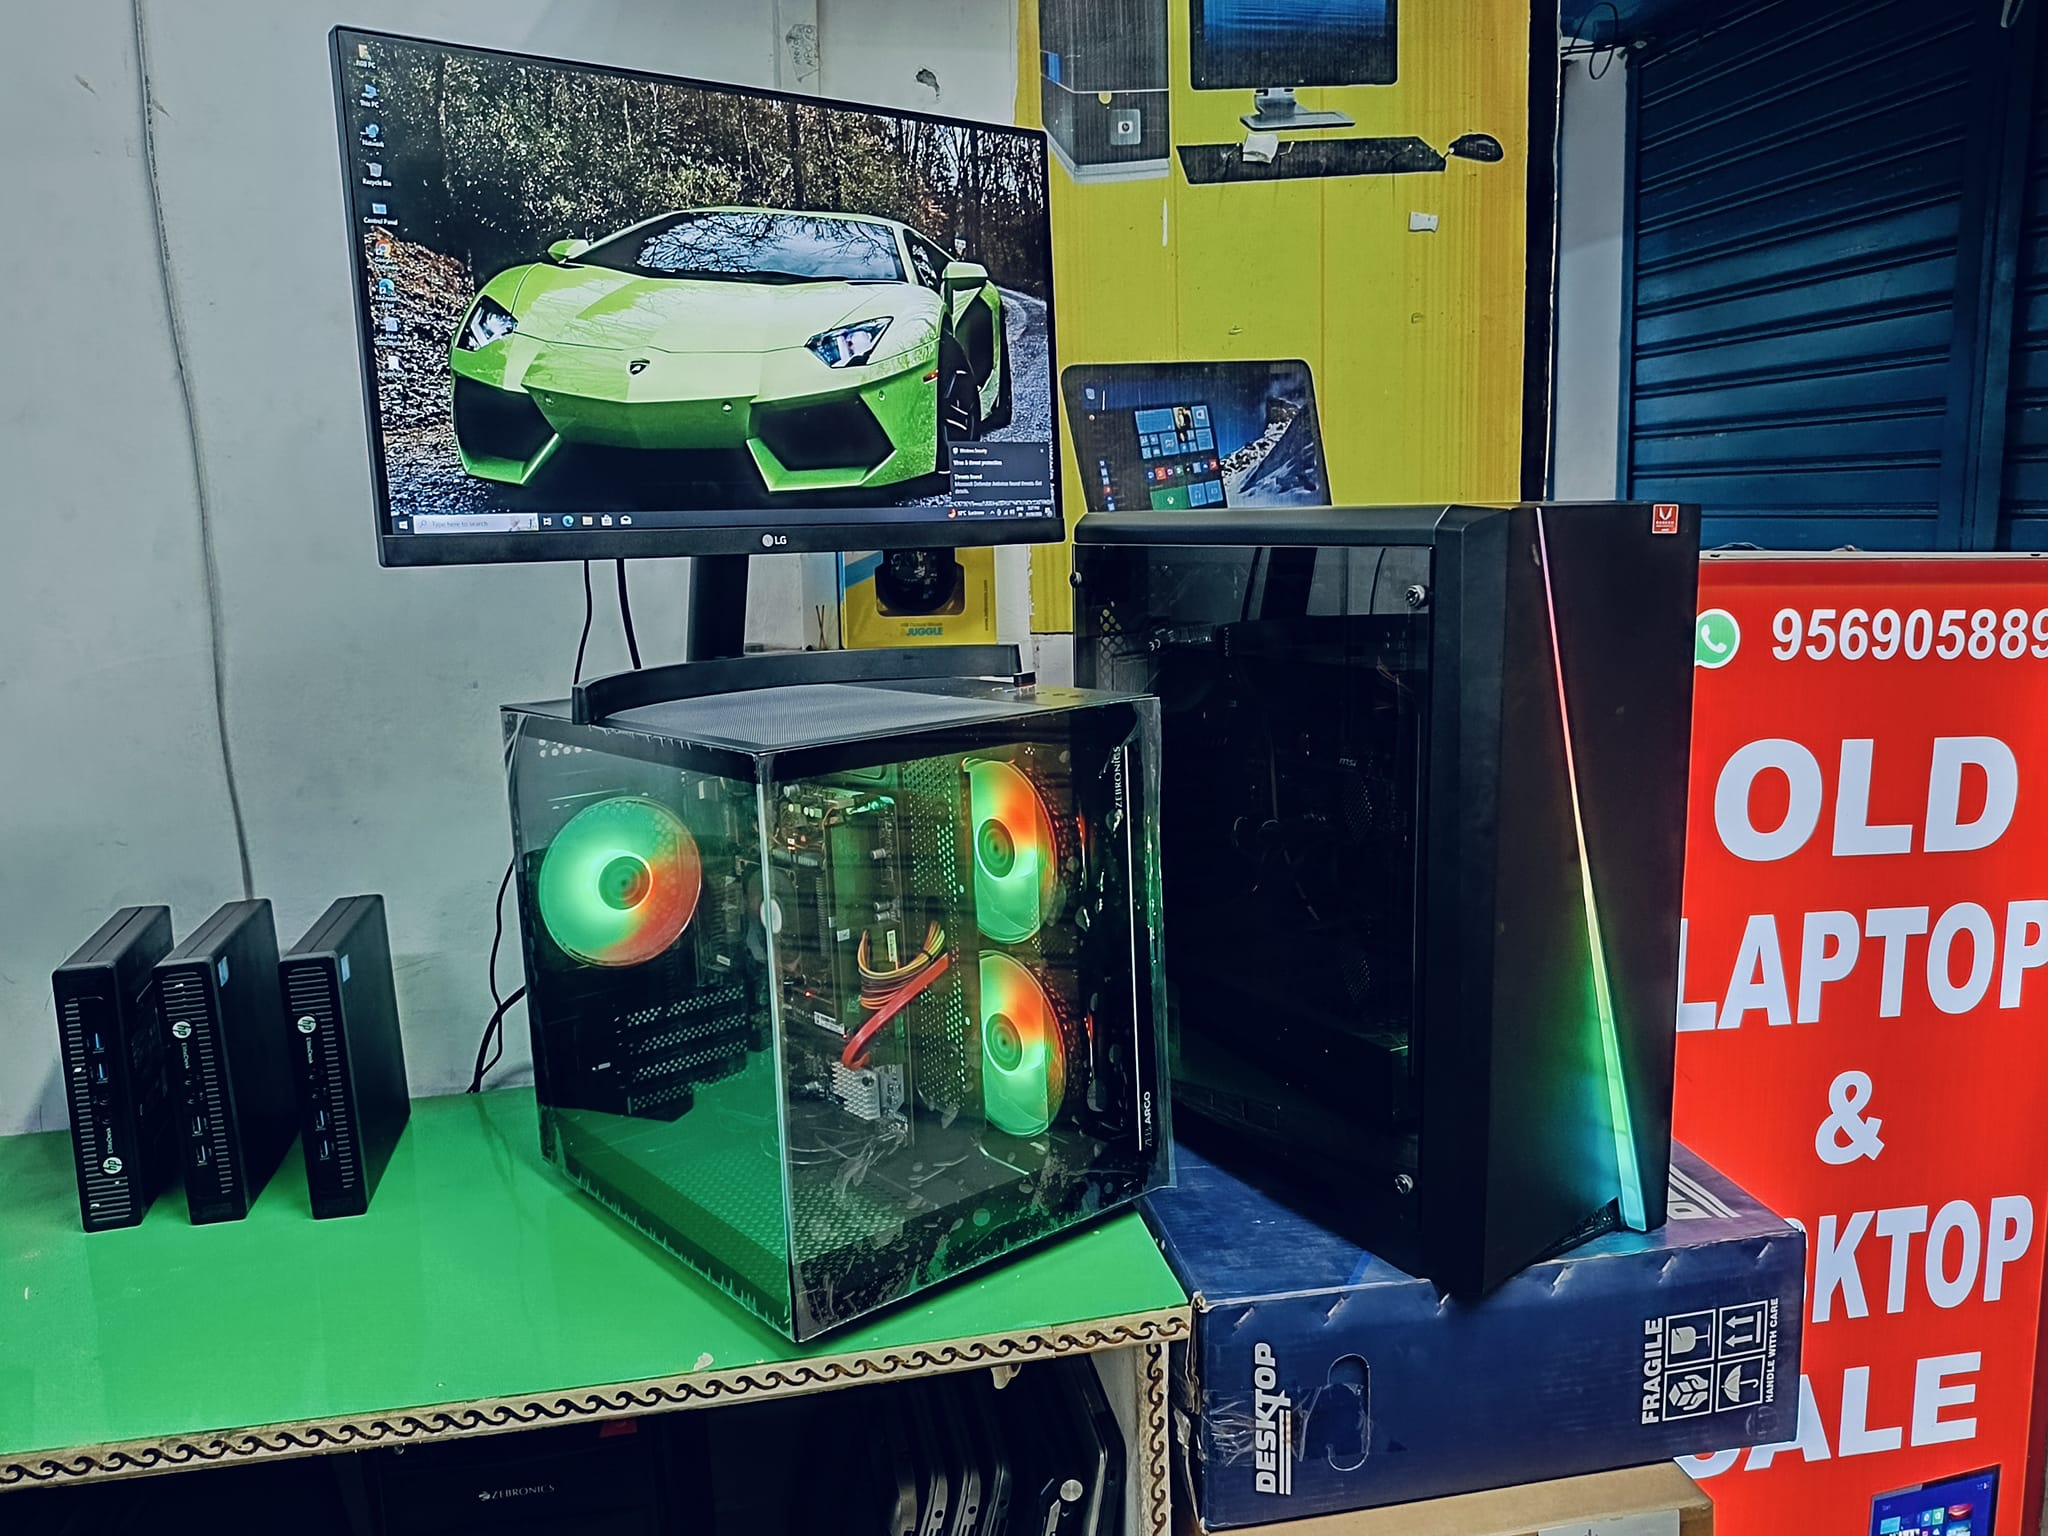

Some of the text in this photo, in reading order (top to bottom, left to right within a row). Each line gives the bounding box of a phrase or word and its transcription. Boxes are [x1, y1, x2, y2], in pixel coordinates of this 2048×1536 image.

[774, 535, 787, 545] LG
[906, 627, 943, 637] JUGGLE
[1771, 607, 2048, 661] 956905889
[1713, 736, 2018, 862] OLD
[1675, 899, 2048, 1033] LAPTOP
[1143, 1091, 1152, 1125] ARGO
[1815, 1070, 1885, 1166] &
[1784, 1194, 2034, 1325] KTOP
[1641, 1317, 1663, 1425] FRAGILE
[1765, 1298, 1779, 1403] HANDLE WITH CARE
[1254, 1342, 1292, 1494] DESKTOP
[1673, 1350, 1982, 1480] ALE
